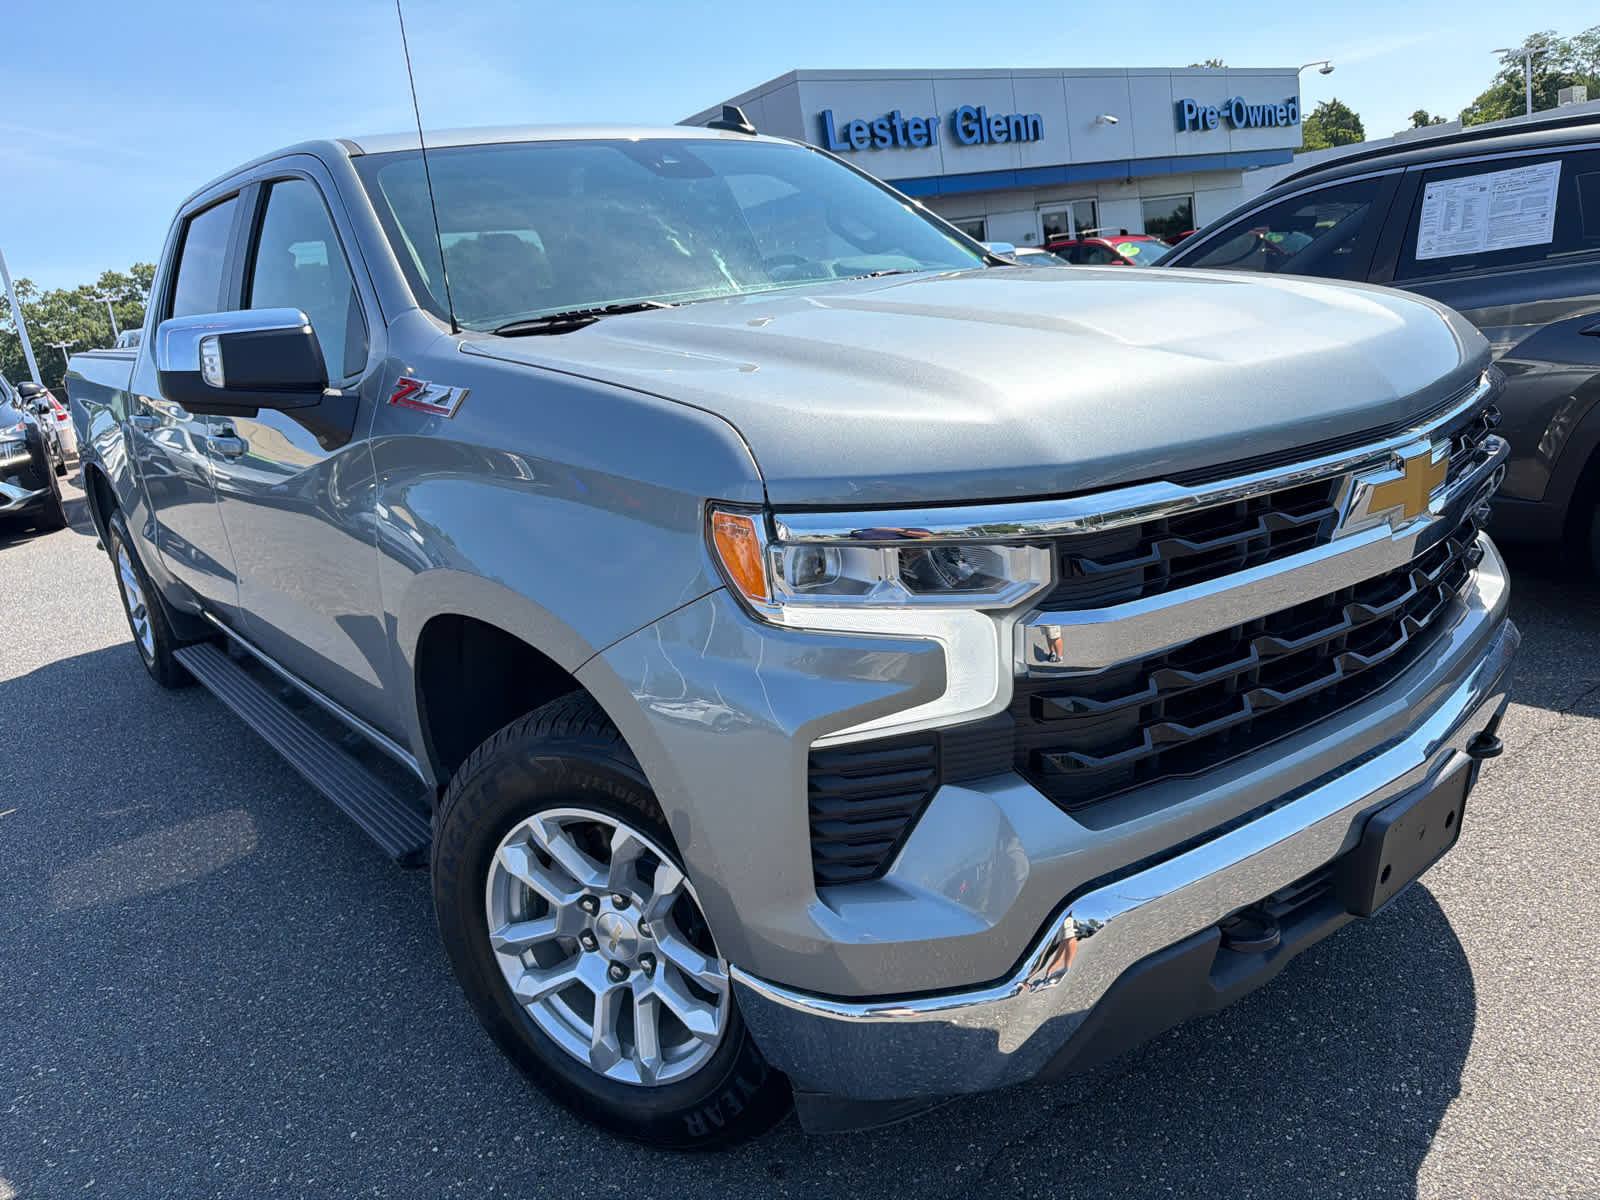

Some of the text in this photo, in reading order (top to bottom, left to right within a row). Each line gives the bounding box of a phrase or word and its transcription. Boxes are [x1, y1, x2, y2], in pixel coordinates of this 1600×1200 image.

[820, 104, 1045, 151] Lester Glenn
[1178, 95, 1300, 132] Pre-Owned
[387, 375, 470, 419] Z71
